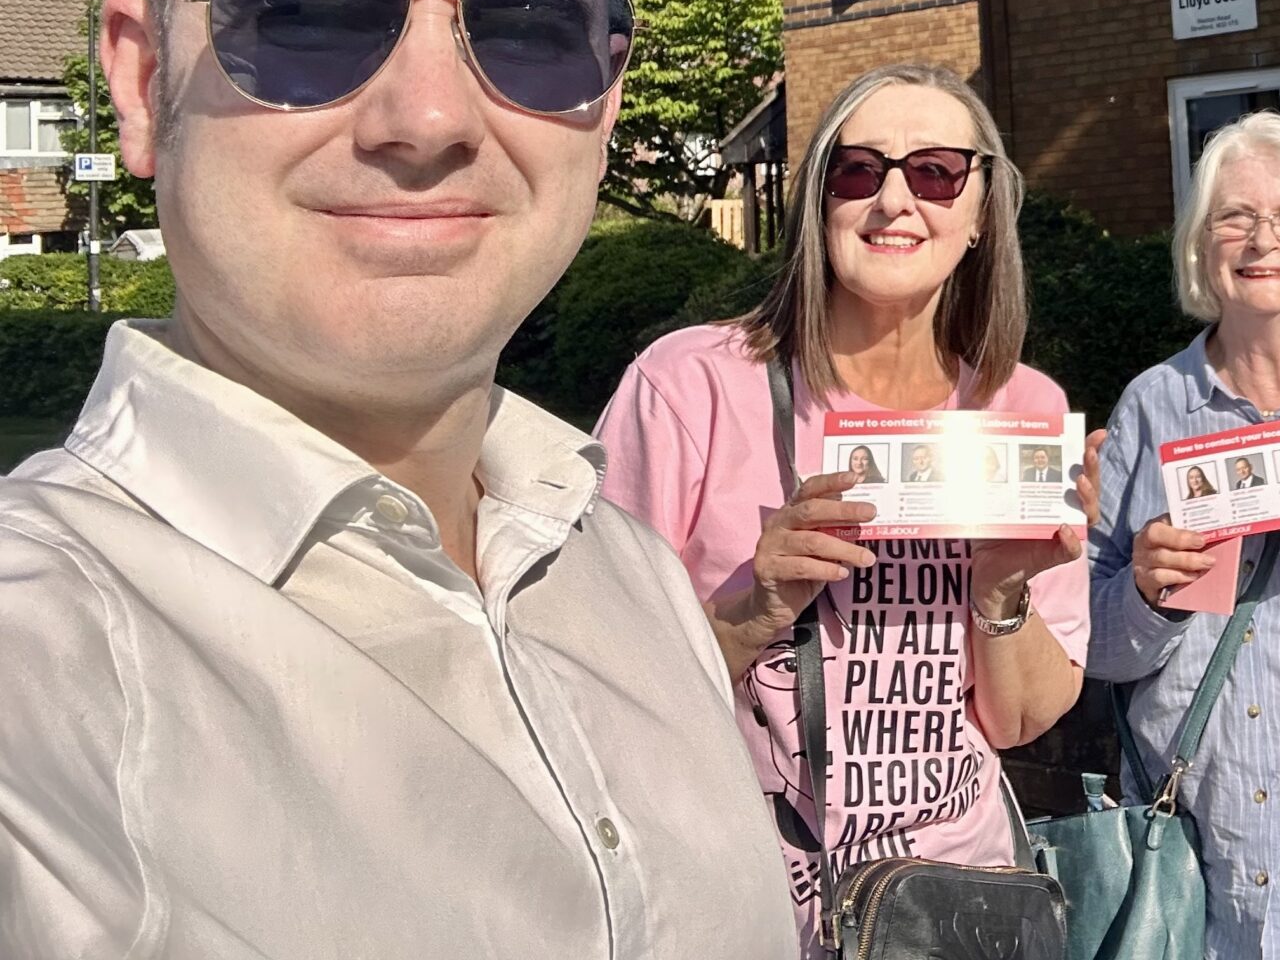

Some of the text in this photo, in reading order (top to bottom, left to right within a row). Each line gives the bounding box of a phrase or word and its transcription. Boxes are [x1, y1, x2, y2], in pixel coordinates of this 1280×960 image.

[81, 158, 91, 170] P
[839, 419, 865, 428] How
[866, 418, 879, 428] to
[880, 417, 925, 428] contact
[1020, 419, 1050, 429] team
[1173, 445, 1194, 456] How
[1193, 442, 1205, 451] to
[1204, 435, 1241, 449] contact
[1240, 432, 1262, 446] your
[836, 522, 920, 537] Trafford Labour
[852, 562, 972, 606] BELON
[849, 609, 959, 655] IN ALL
[842, 708, 964, 756] WHERE
